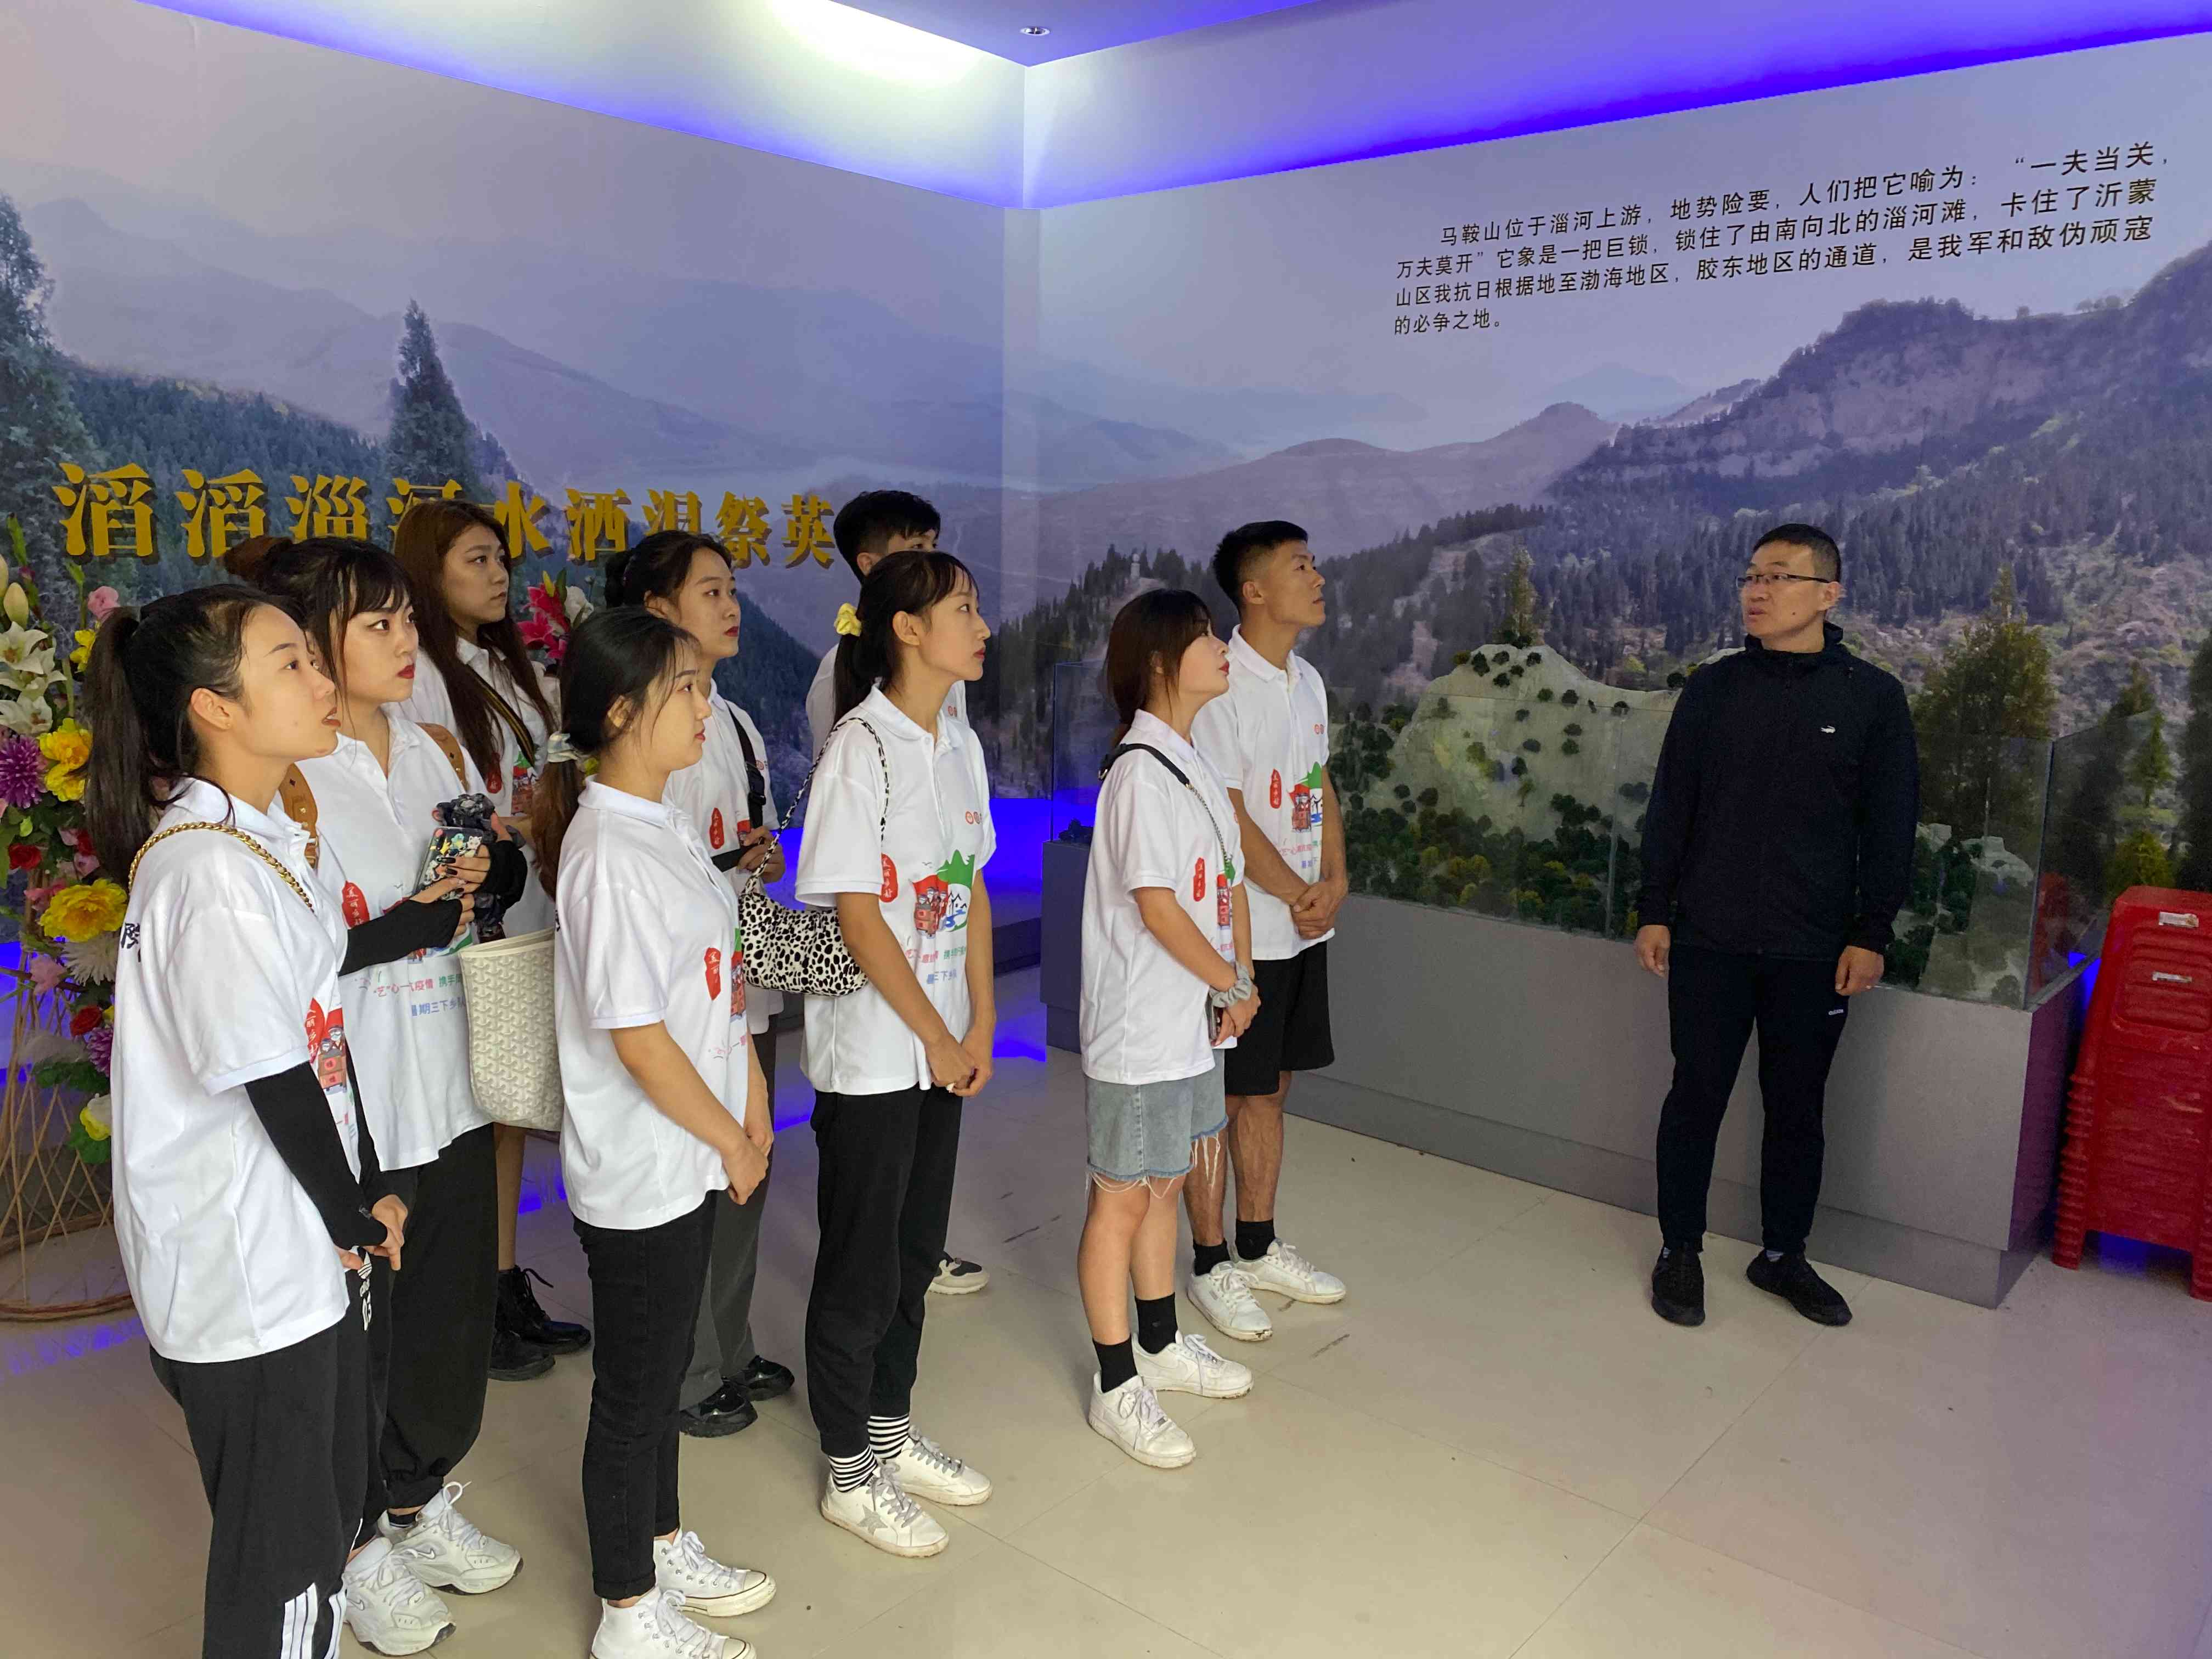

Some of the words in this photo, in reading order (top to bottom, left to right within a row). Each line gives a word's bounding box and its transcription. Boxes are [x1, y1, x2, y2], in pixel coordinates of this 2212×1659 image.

[1394, 308, 1501, 335] 的必争之地。
[52, 462, 835, 564] 滔滔淄水洒泪祭英
